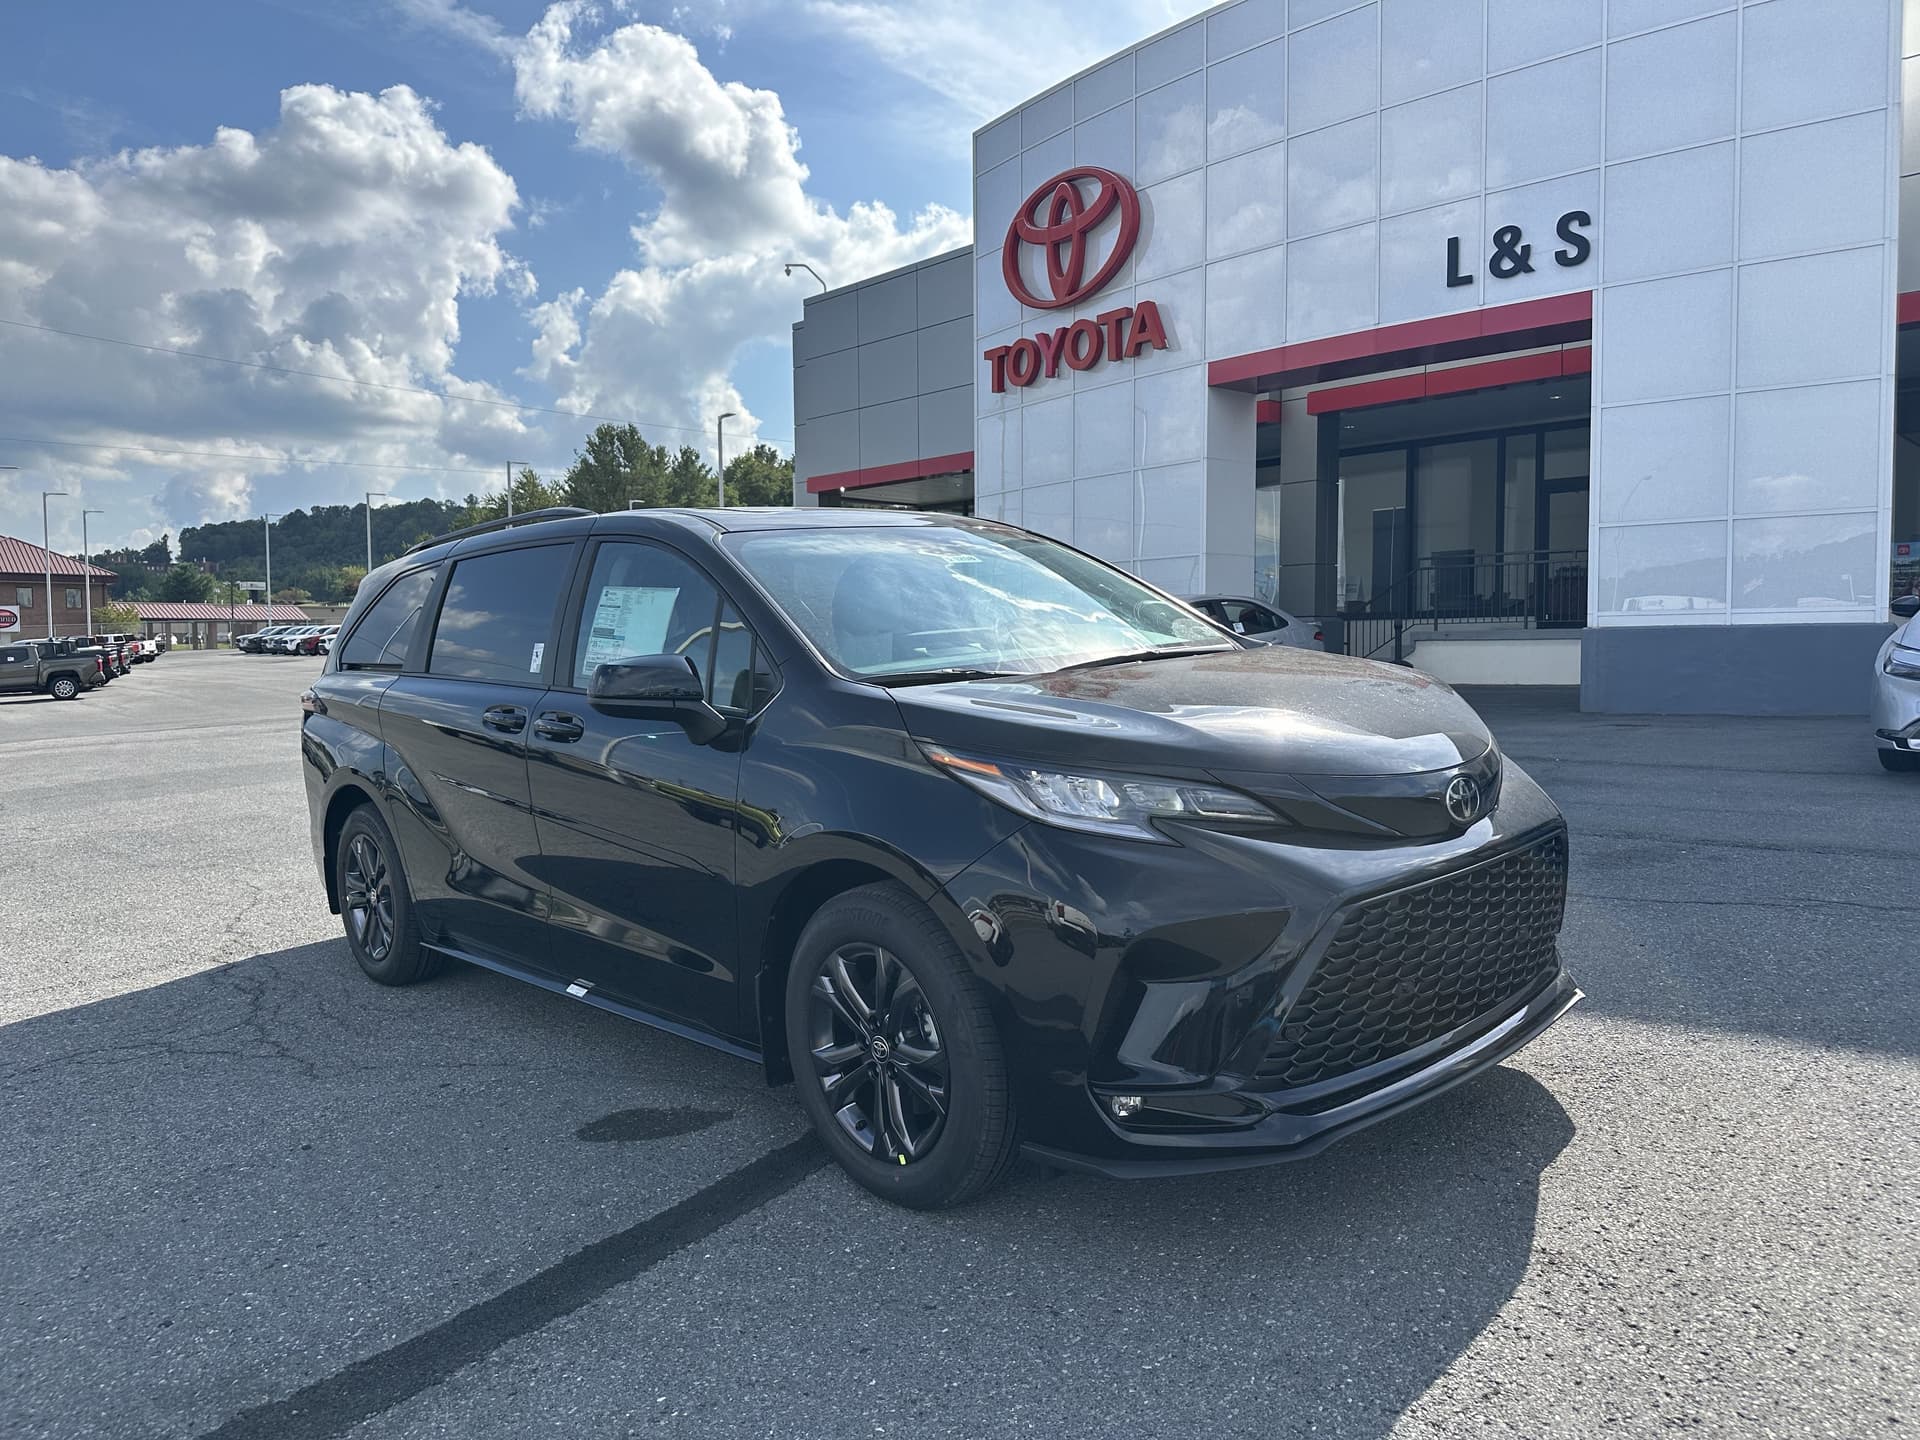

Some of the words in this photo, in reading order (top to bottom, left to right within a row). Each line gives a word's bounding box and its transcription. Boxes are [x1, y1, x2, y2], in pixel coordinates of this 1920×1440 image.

[1447, 236, 1473, 287] L
[1489, 225, 1535, 279] &
[1555, 210, 1591, 267] S
[984, 300, 1168, 393] TOYOTA
